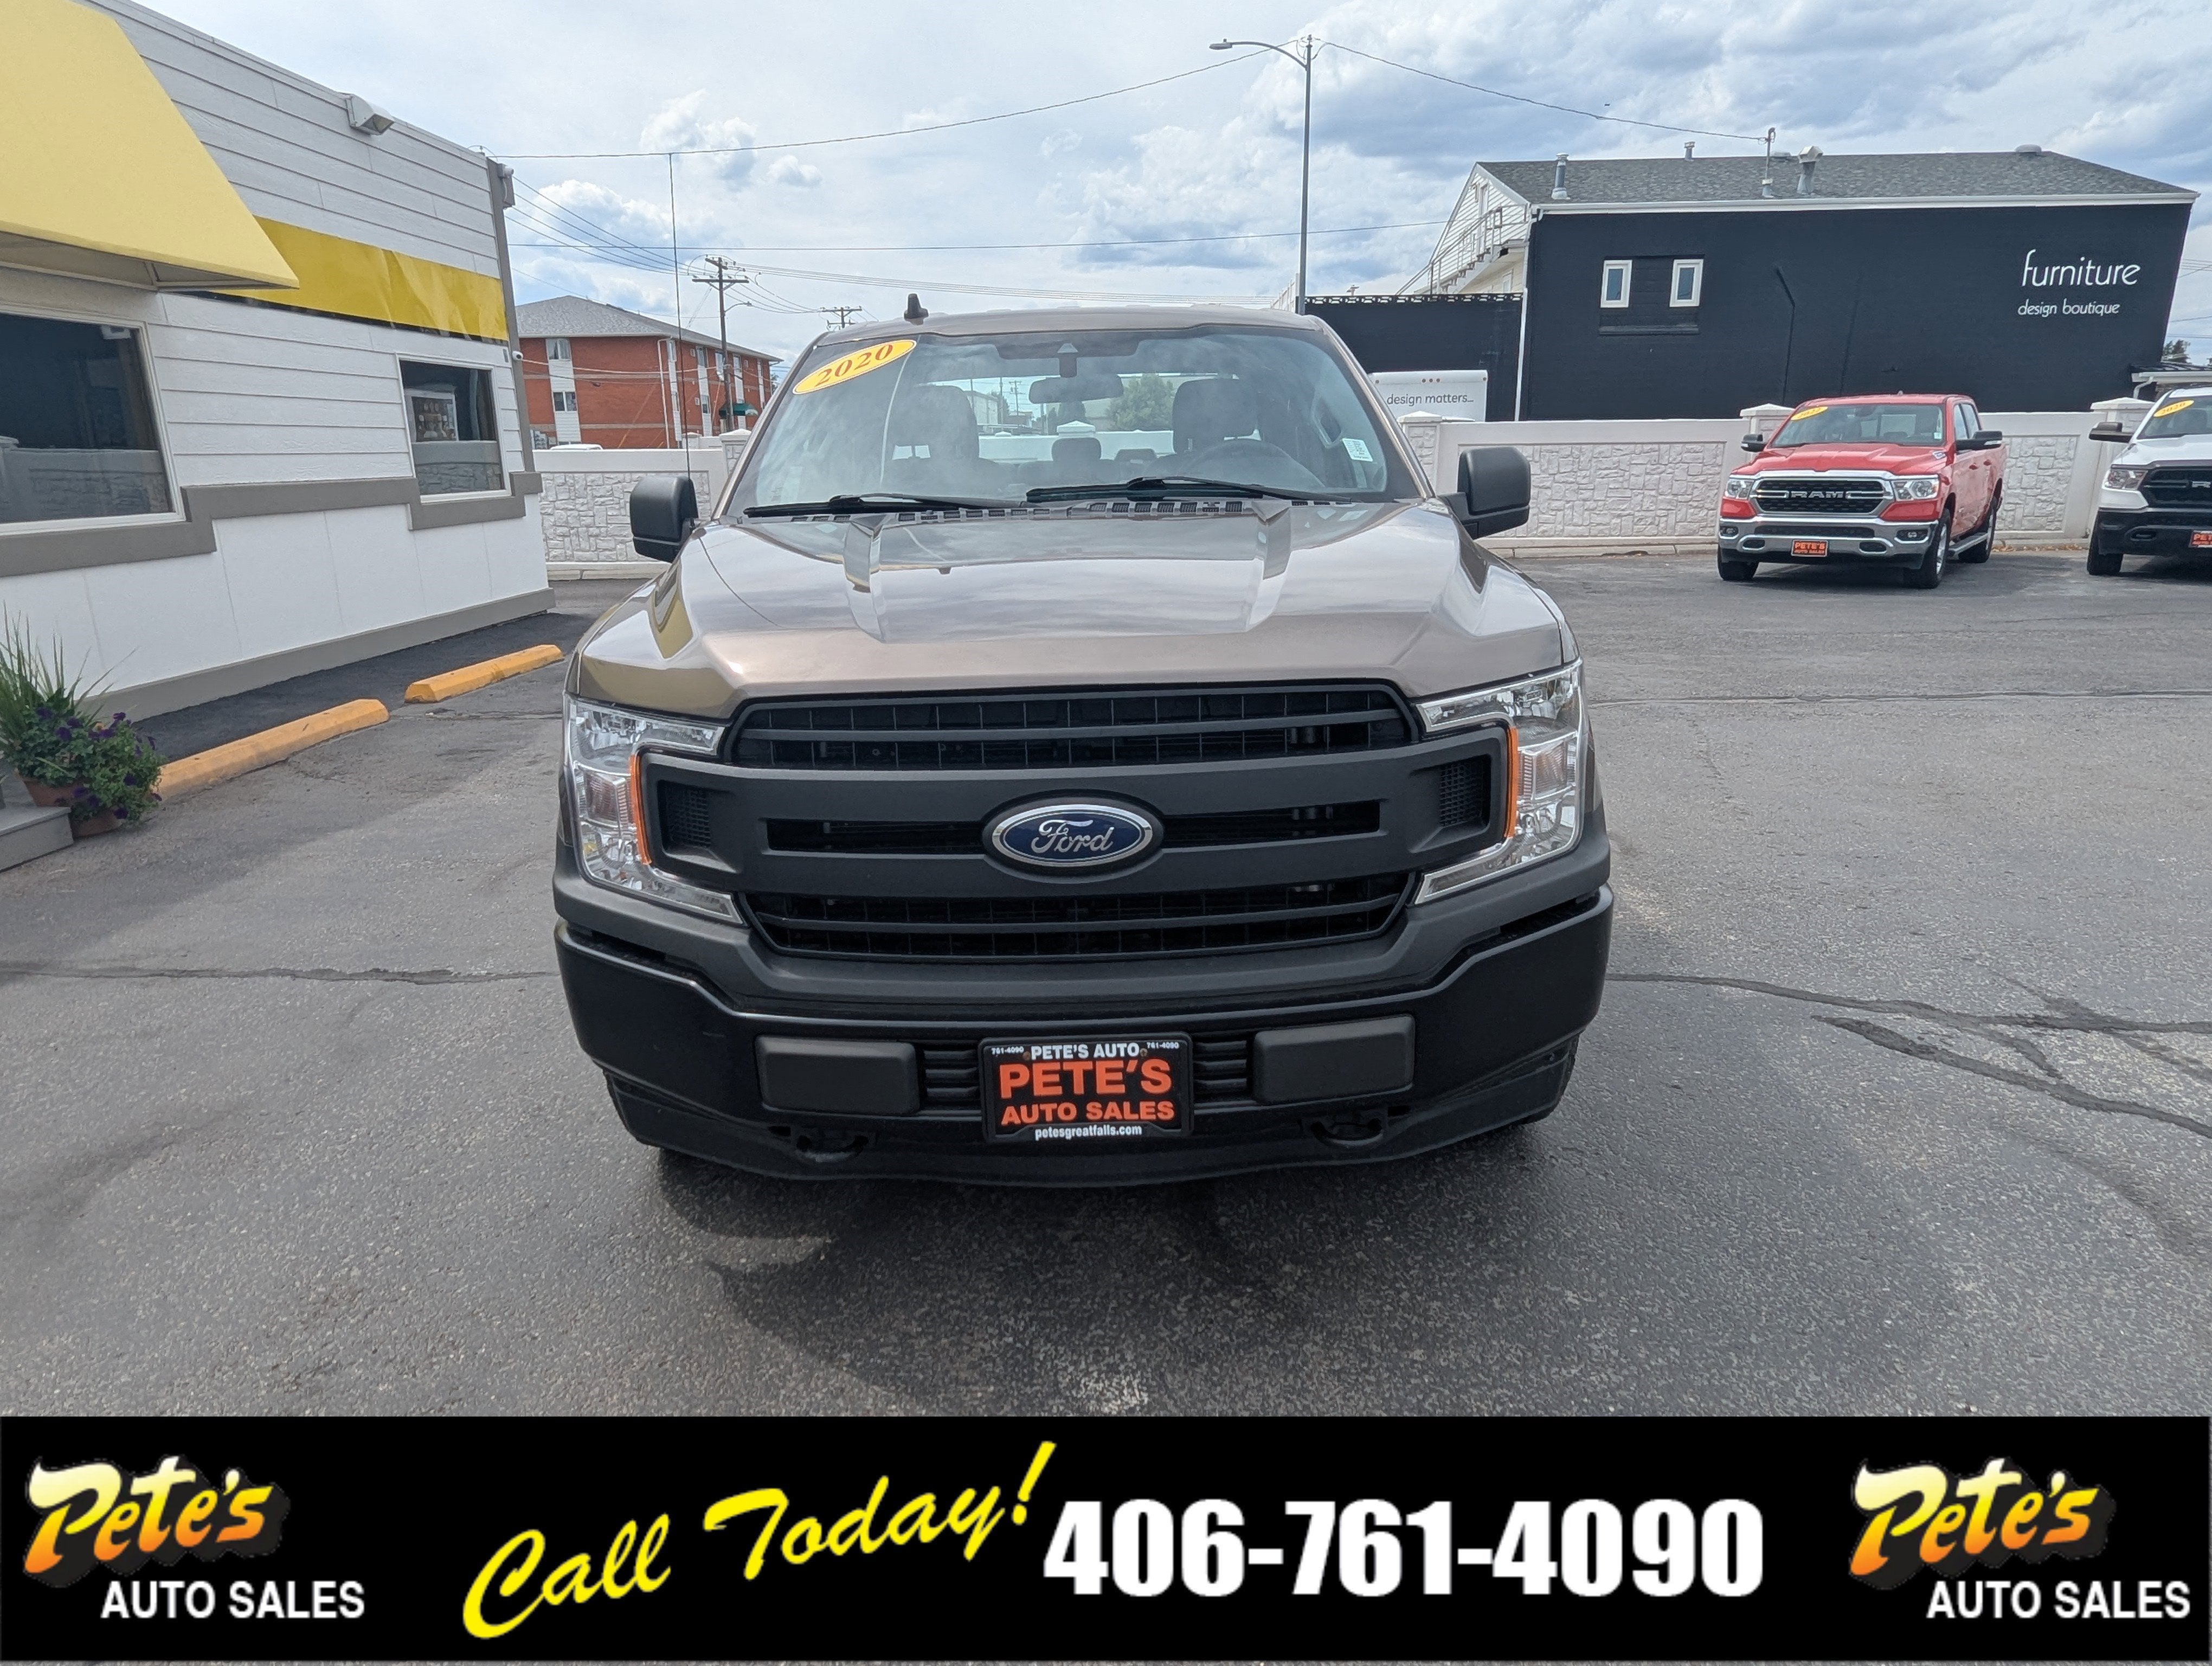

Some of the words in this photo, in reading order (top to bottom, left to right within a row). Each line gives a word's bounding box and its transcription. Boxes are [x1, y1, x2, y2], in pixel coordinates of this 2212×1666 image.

[2022, 248, 2141, 287] furniture
[2017, 298, 2058, 318] design
[2062, 298, 2120, 317] boutique
[814, 344, 893, 387] 2020
[1386, 394, 1422, 407] design
[1031, 819, 1114, 854] Ford
[1031, 1045, 1089, 1060] PETE'S
[1094, 1043, 1139, 1058] AUTO
[1000, 1058, 1172, 1099] PETE'S
[1001, 1102, 1077, 1125] AUTO
[1086, 1101, 1174, 1120] SALES
[1035, 1124, 1142, 1140] petesgreatfalls.com
